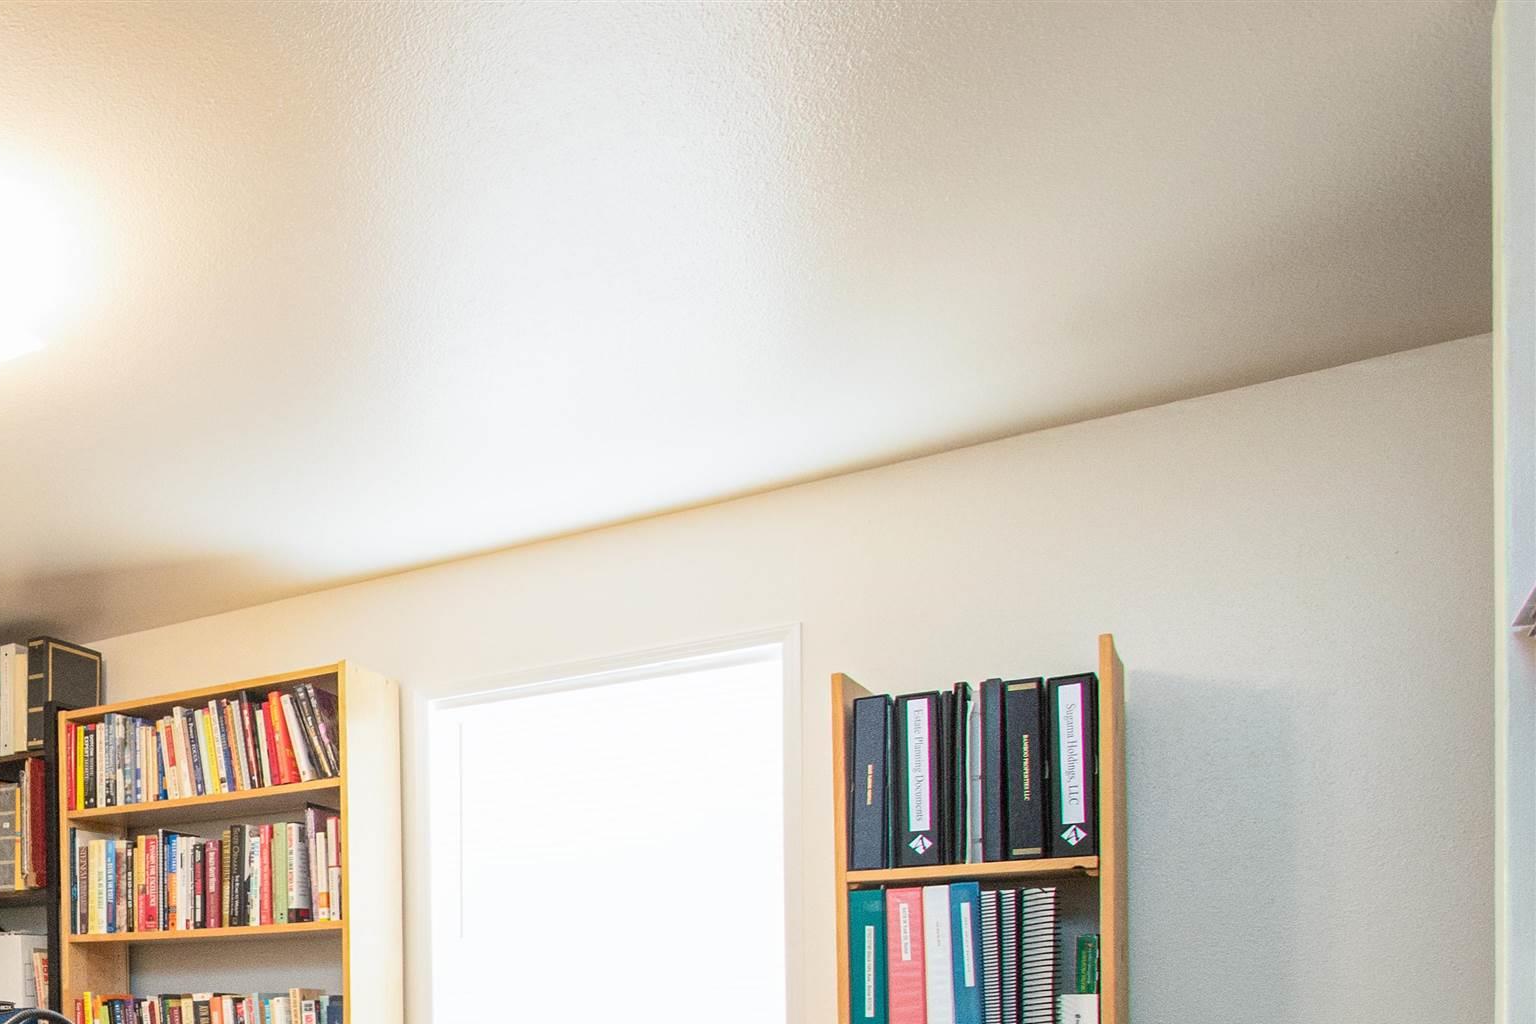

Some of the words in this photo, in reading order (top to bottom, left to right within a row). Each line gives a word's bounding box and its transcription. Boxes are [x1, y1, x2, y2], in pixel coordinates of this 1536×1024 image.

[914, 709, 924, 734] Estate
[912, 737, 924, 773] Planning
[914, 775, 924, 821] Documents
[1068, 785, 1079, 805] LLC
[232, 846, 240, 874] ORMAN
[199, 1006, 209, 1016] AYN
